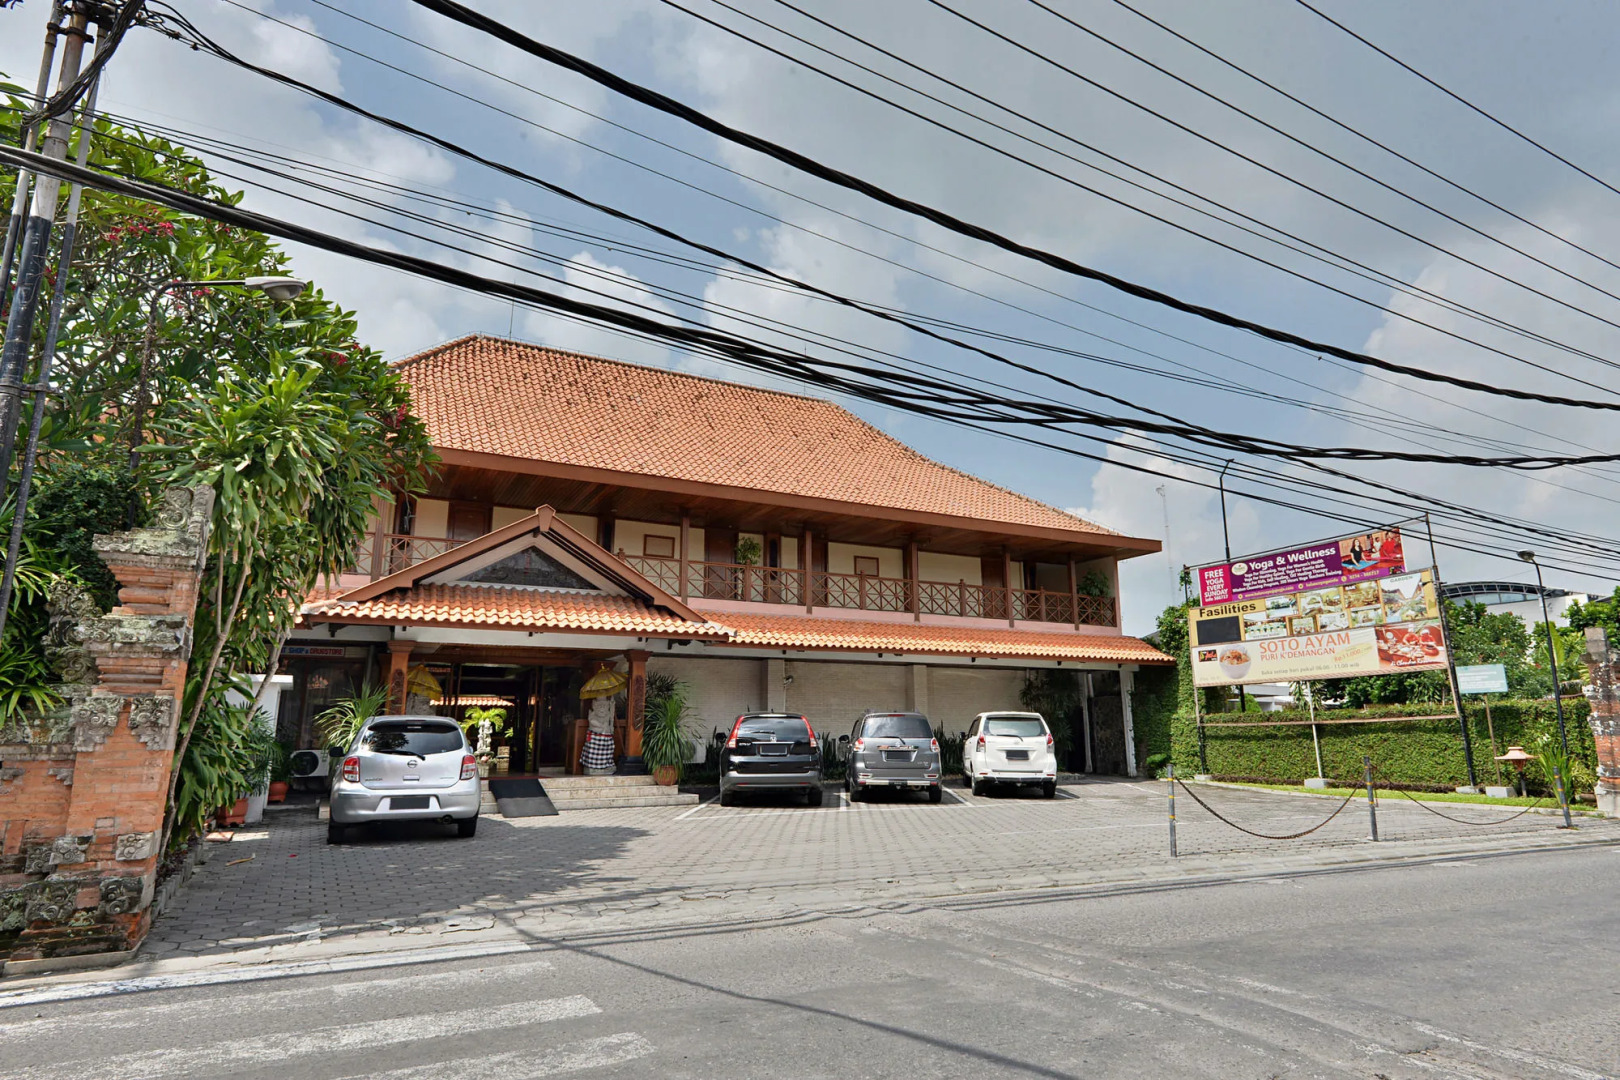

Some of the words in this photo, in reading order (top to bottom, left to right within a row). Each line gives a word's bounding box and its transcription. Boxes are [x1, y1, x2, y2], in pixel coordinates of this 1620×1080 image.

[1249, 560, 1274, 570] Yoga
[1276, 556, 1286, 565] &
[1287, 547, 1336, 563] Wellness
[1205, 568, 1224, 579] FREE
[1206, 577, 1224, 585] YOGA
[1204, 589, 1228, 597] SUNDAY
[1199, 603, 1256, 618] Fasilities
[1259, 638, 1300, 654] SOTO
[1305, 632, 1351, 649] AYAM
